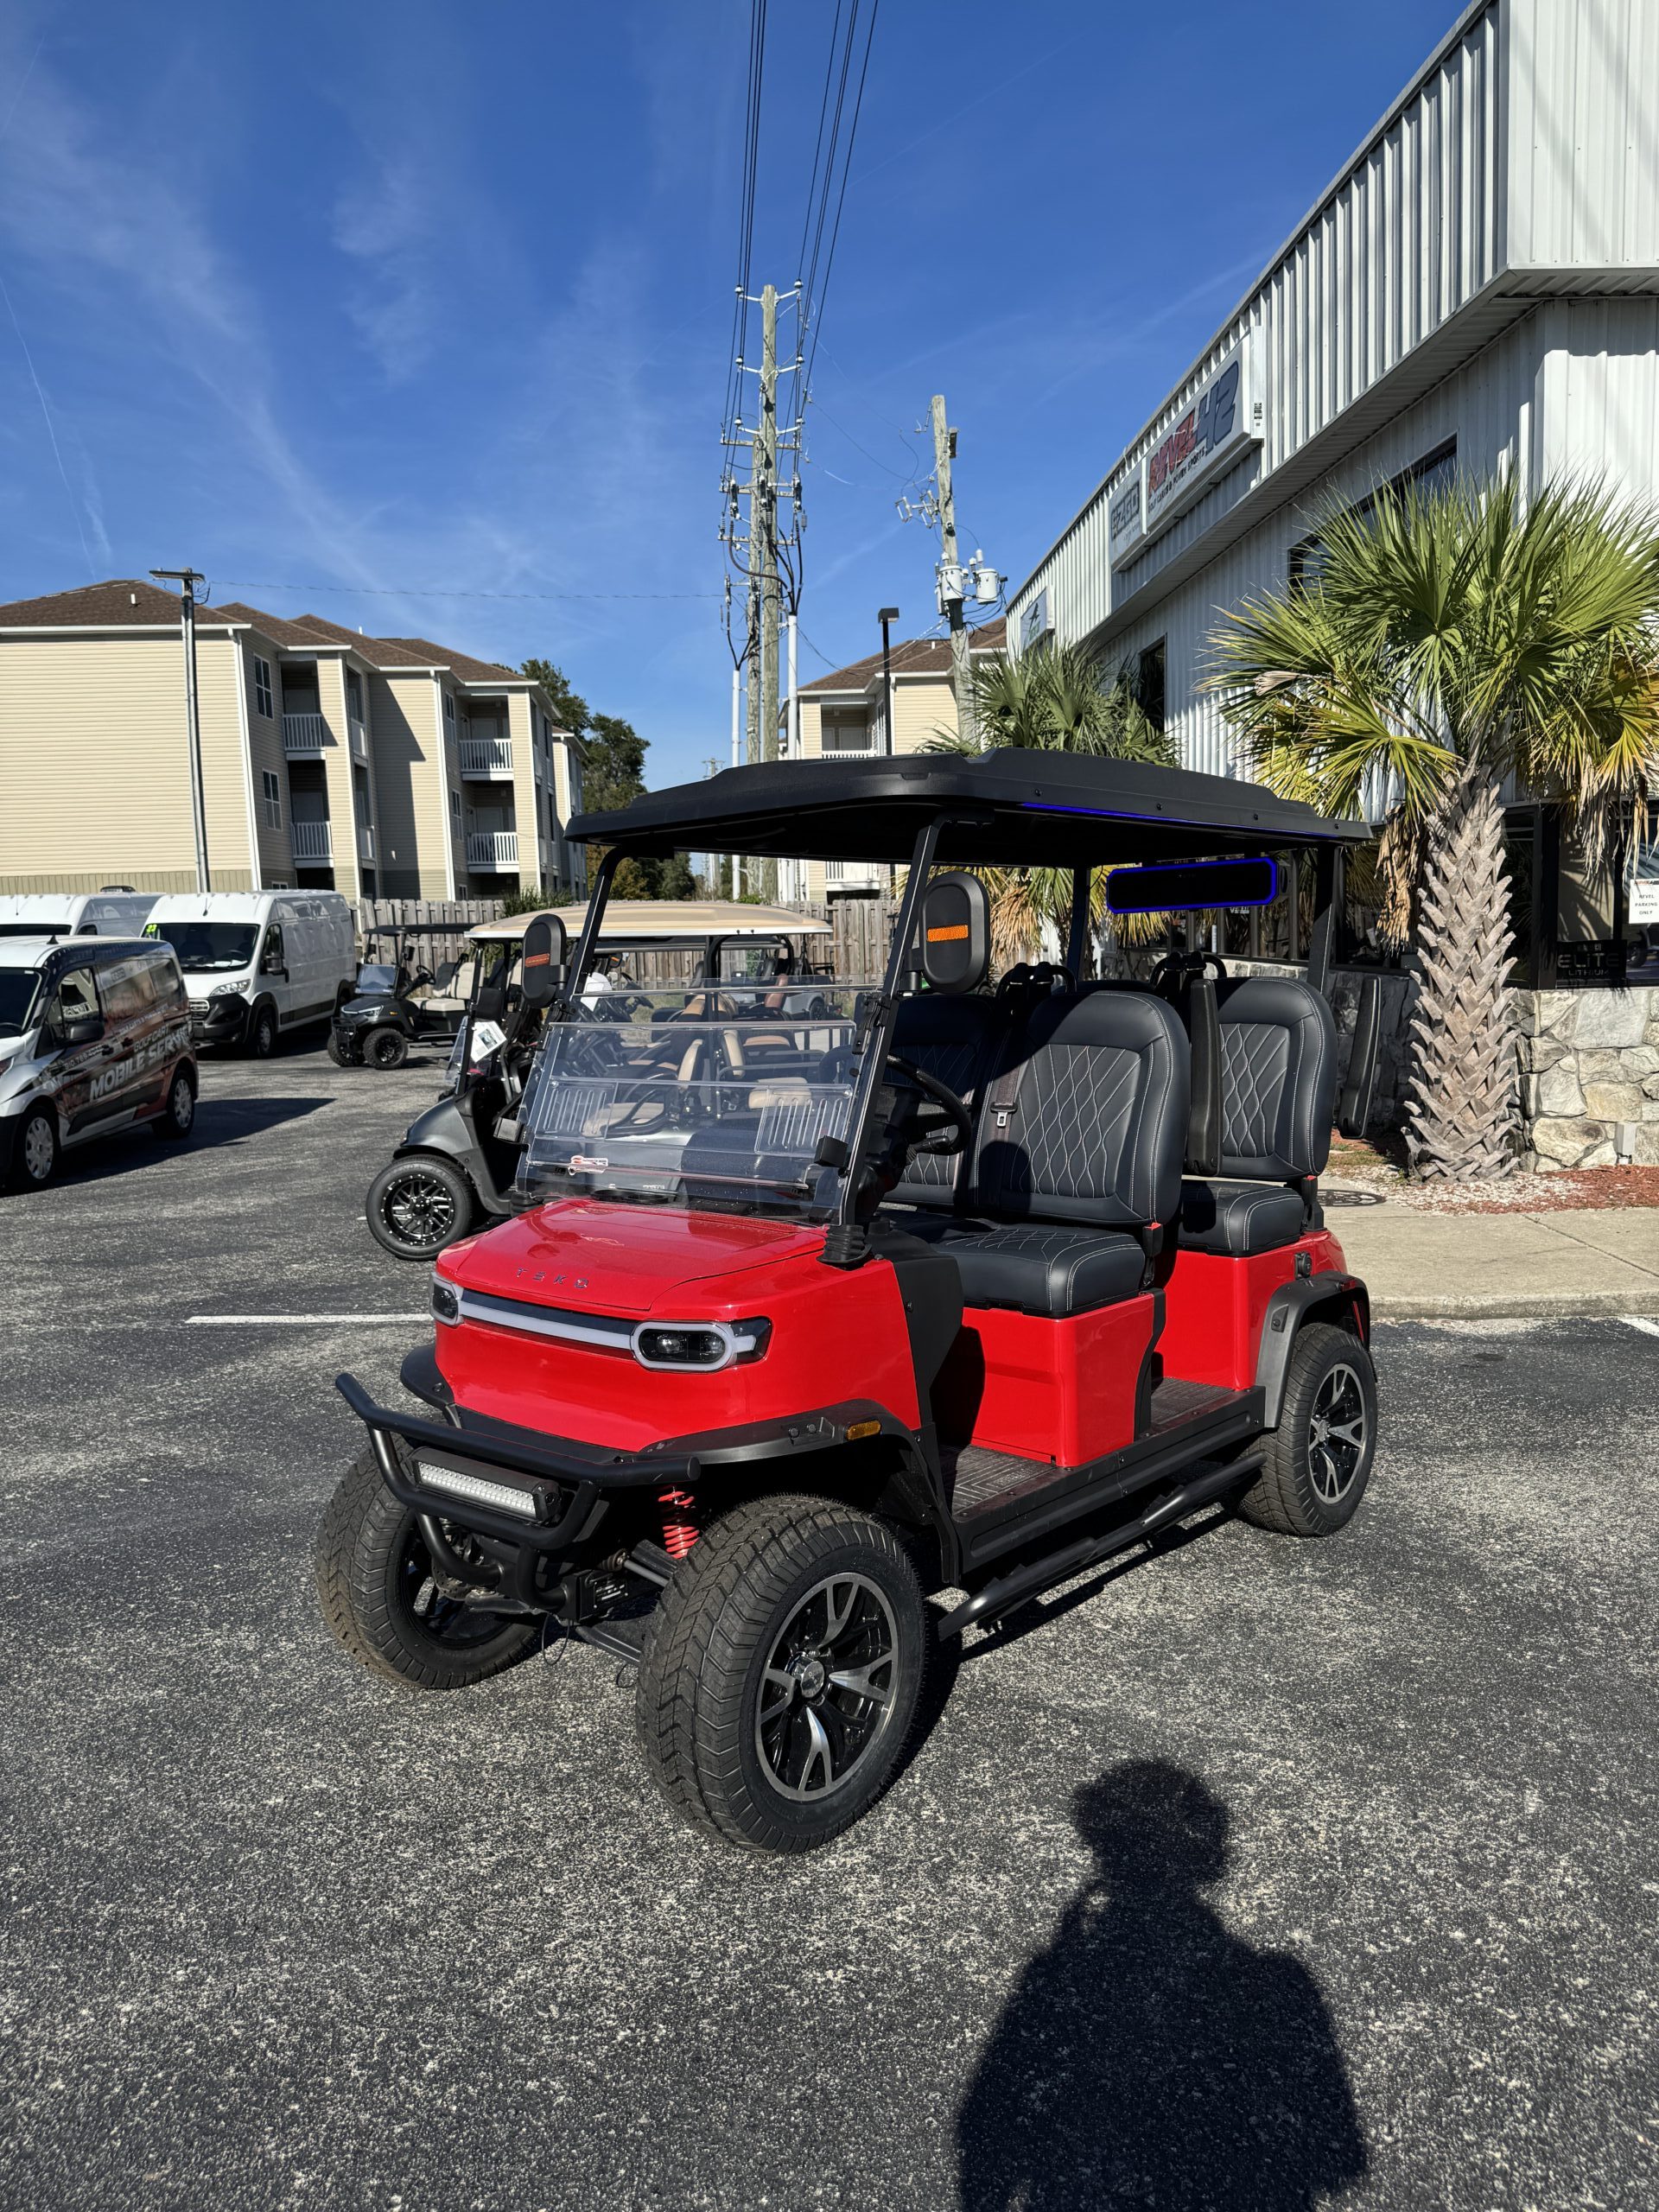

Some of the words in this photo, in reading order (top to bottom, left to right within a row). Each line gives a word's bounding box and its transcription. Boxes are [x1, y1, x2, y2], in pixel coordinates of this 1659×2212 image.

[1196, 360, 1239, 456] 42
[90, 1051, 145, 1103] MOBILE
[516, 1267, 589, 1289] TEKO
